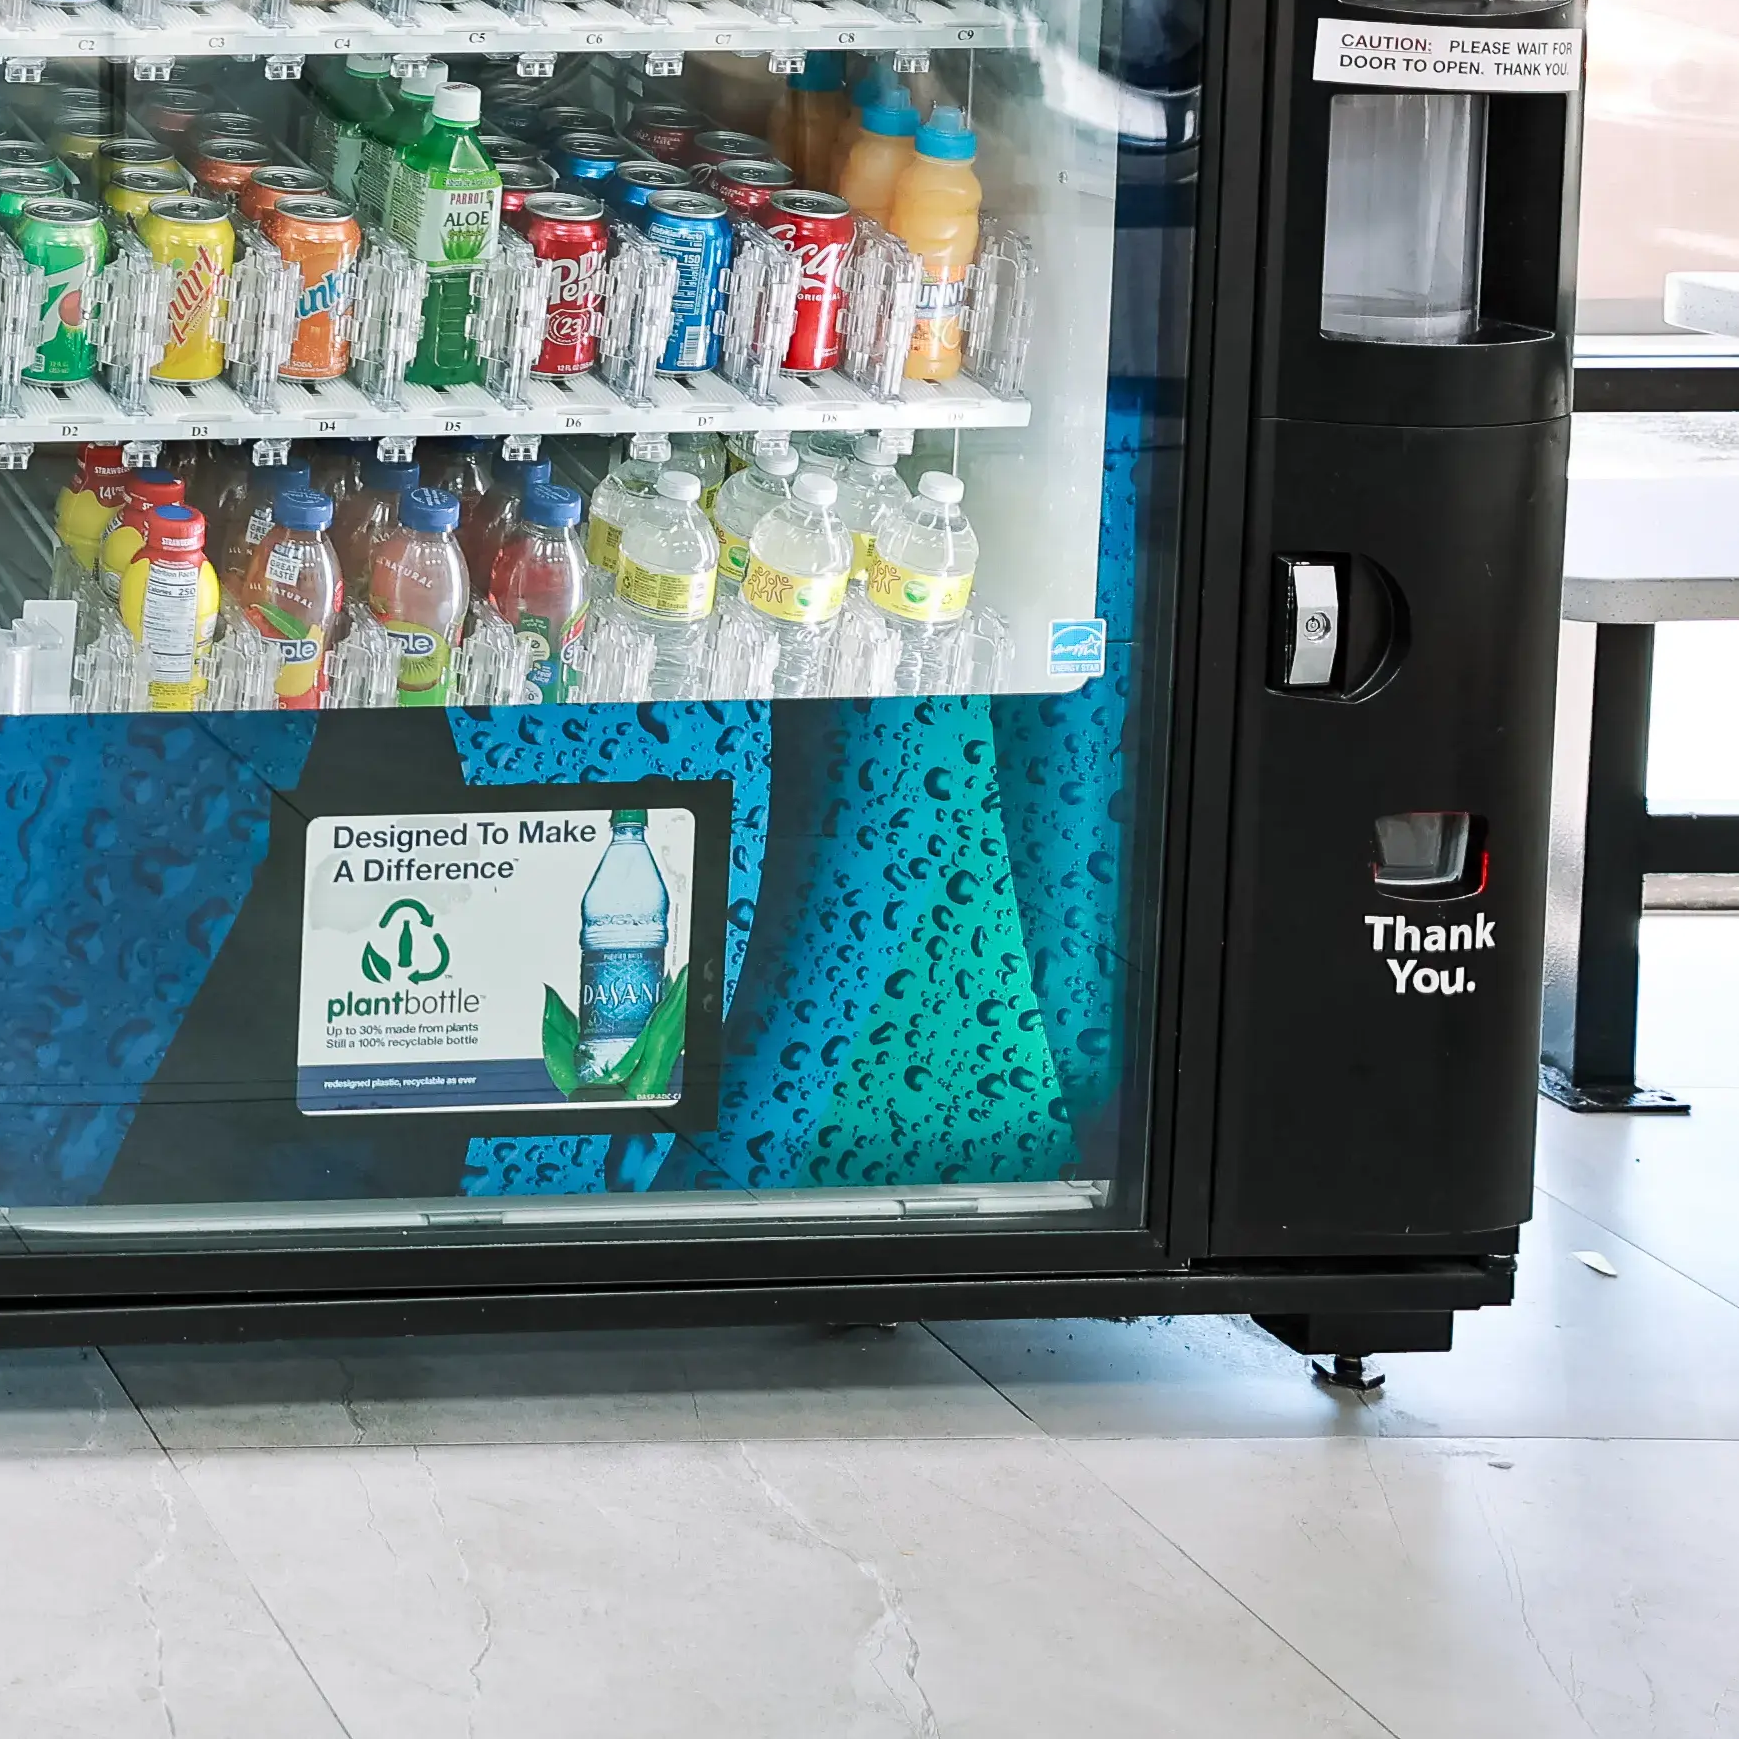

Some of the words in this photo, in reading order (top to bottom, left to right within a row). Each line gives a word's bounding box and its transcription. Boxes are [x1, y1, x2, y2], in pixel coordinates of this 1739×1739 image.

[78, 39, 94, 52] C2
[334, 37, 351, 49] C4
[585, 33, 603, 46] C6
[1340, 33, 1432, 52] CAUTION:
[1449, 40, 1510, 55] PLEASE
[1517, 42, 1548, 55] WAIT
[1552, 43, 1573, 56] FOR
[1339, 55, 1396, 71] DOOR
[1403, 58, 1427, 72] TO
[1433, 61, 1484, 75] OPEN.
[1495, 63, 1541, 76] THANK
[1544, 63, 1569, 76] YOU.
[450, 192, 484, 205] PARROT
[443, 209, 490, 228] ALOE
[319, 419, 336, 432] D4
[697, 416, 715, 429] D7
[61, 425, 78, 438] D2
[1051, 663, 1077, 672] ENERGY
[1079, 663, 1100, 672] STAR
[333, 822, 468, 853] Designed
[476, 821, 509, 845] To
[519, 819, 597, 844] Make
[333, 859, 355, 882] A
[1364, 913, 1496, 952] Thank
[1386, 958, 1476, 995] You.
[583, 981, 663, 1006] DASANI
[326, 1025, 343, 1037] Up
[345, 1026, 357, 1034] to
[359, 1025, 382, 1034] 30%
[384, 1025, 416, 1034] made
[418, 1023, 444, 1033] from
[445, 1022, 479, 1034] plants
[326, 1037, 346, 1049] Still
[358, 1037, 386, 1048] 100%
[388, 1036, 444, 1048] recyclable
[446, 1034, 479, 1046] bottle
[324, 1078, 371, 1090] redesigned
[372, 1078, 402, 1089] plastic,
[403, 1076, 445, 1088] recyclable
[458, 1076, 477, 1085] ever
